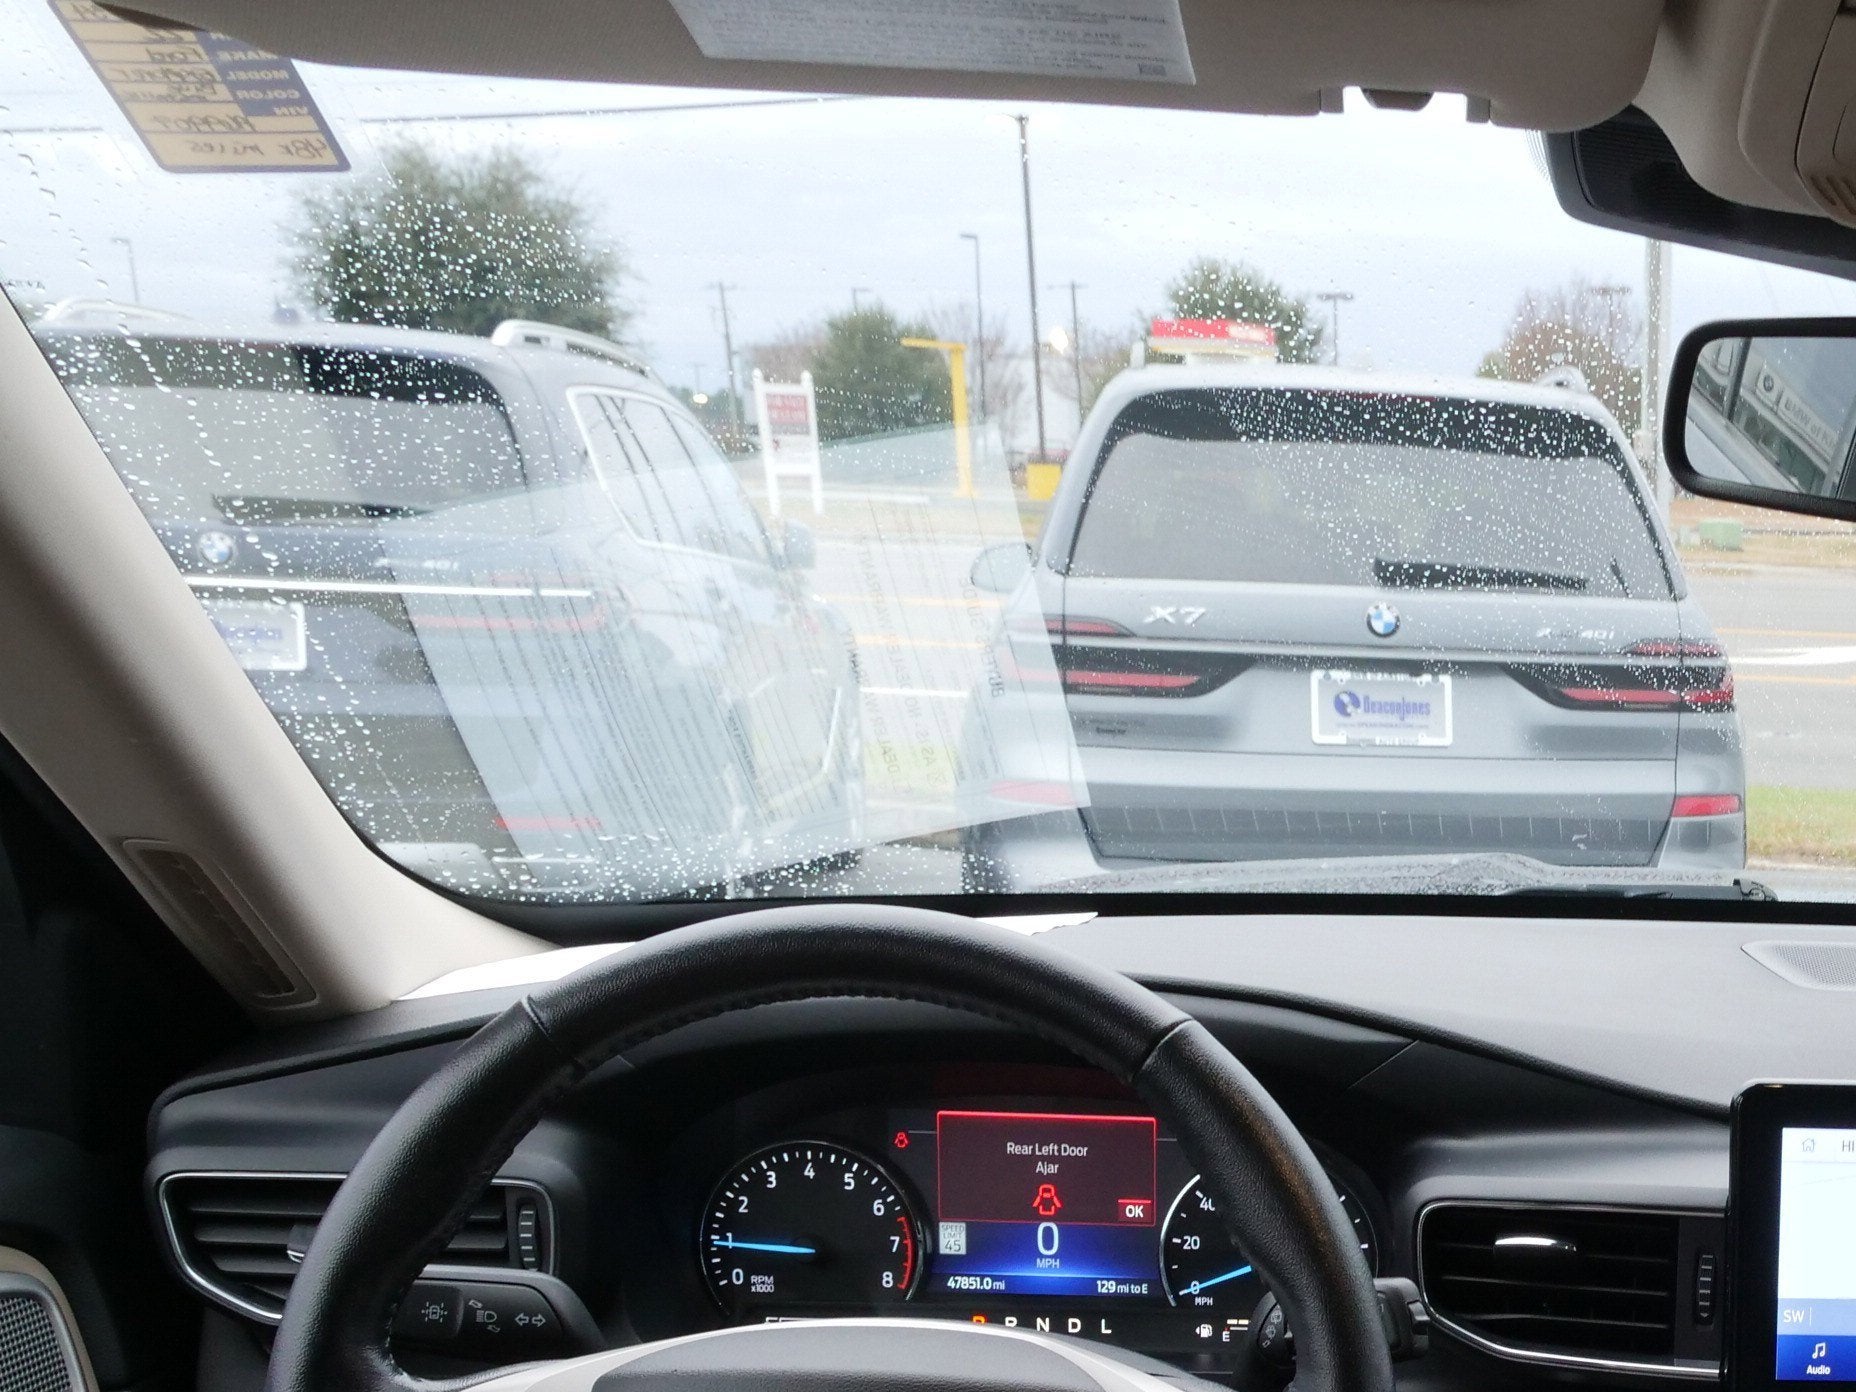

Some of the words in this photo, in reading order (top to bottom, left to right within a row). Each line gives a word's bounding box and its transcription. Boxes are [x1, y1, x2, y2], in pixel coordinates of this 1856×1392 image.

[1143, 606, 1207, 624] X7
[1006, 1141, 1033, 1156] Rear
[1035, 1143, 1059, 1156] Left
[1061, 1144, 1088, 1157] Door
[1842, 1139, 1855, 1152] HI
[803, 1162, 816, 1180] 4
[1036, 1161, 1059, 1175] Ajar
[766, 1171, 777, 1189] 3
[844, 1173, 855, 1190] 5
[738, 1196, 749, 1213] 2
[873, 1199, 885, 1216] 6
[1125, 1205, 1144, 1218] OK
[889, 1236, 900, 1253] 7
[1037, 1222, 1060, 1255] 0
[1183, 1236, 1200, 1250] 20
[944, 1240, 961, 1252] 45
[1036, 1258, 1060, 1268] MPH
[732, 1268, 744, 1285] 0
[750, 1275, 774, 1285] RPM
[882, 1271, 893, 1288] 8
[947, 1276, 992, 1291] 47851.0
[993, 1279, 1005, 1290] mi
[750, 1284, 775, 1293] x1000
[1097, 1280, 1116, 1293] 129
[1117, 1282, 1129, 1293] mi
[1130, 1283, 1141, 1294] to
[1142, 1284, 1148, 1294] E
[1190, 1281, 1200, 1295] 0
[1195, 1297, 1213, 1306] MPH
[1783, 1309, 1805, 1323] SW
[1036, 1317, 1050, 1332] N
[1068, 1318, 1081, 1333] D
[1101, 1319, 1112, 1334] L
[1222, 1331, 1230, 1342] E
[1806, 1364, 1831, 1375] Audio
